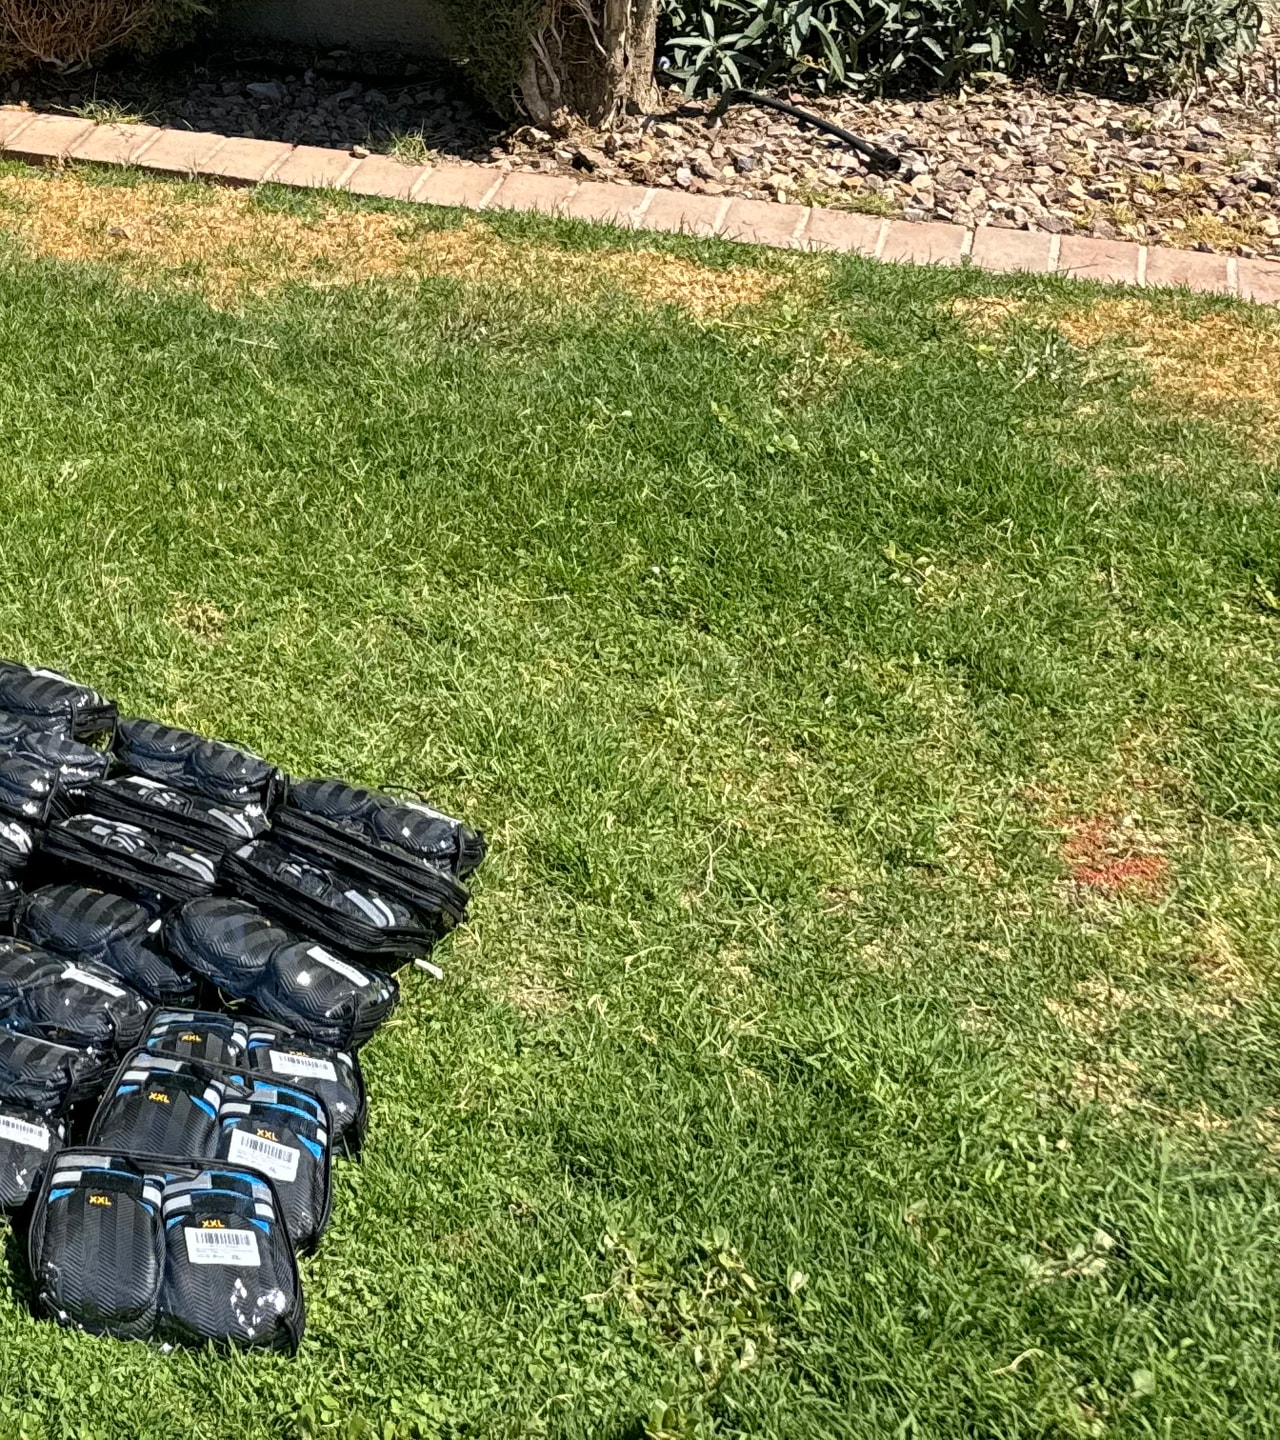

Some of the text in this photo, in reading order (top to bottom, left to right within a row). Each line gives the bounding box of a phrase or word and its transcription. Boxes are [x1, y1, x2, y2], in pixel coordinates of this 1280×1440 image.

[148, 1092, 170, 1104] XXL
[256, 1128, 279, 1142] XXL
[89, 1195, 112, 1206] XXL
[201, 1219, 225, 1229] XXL
